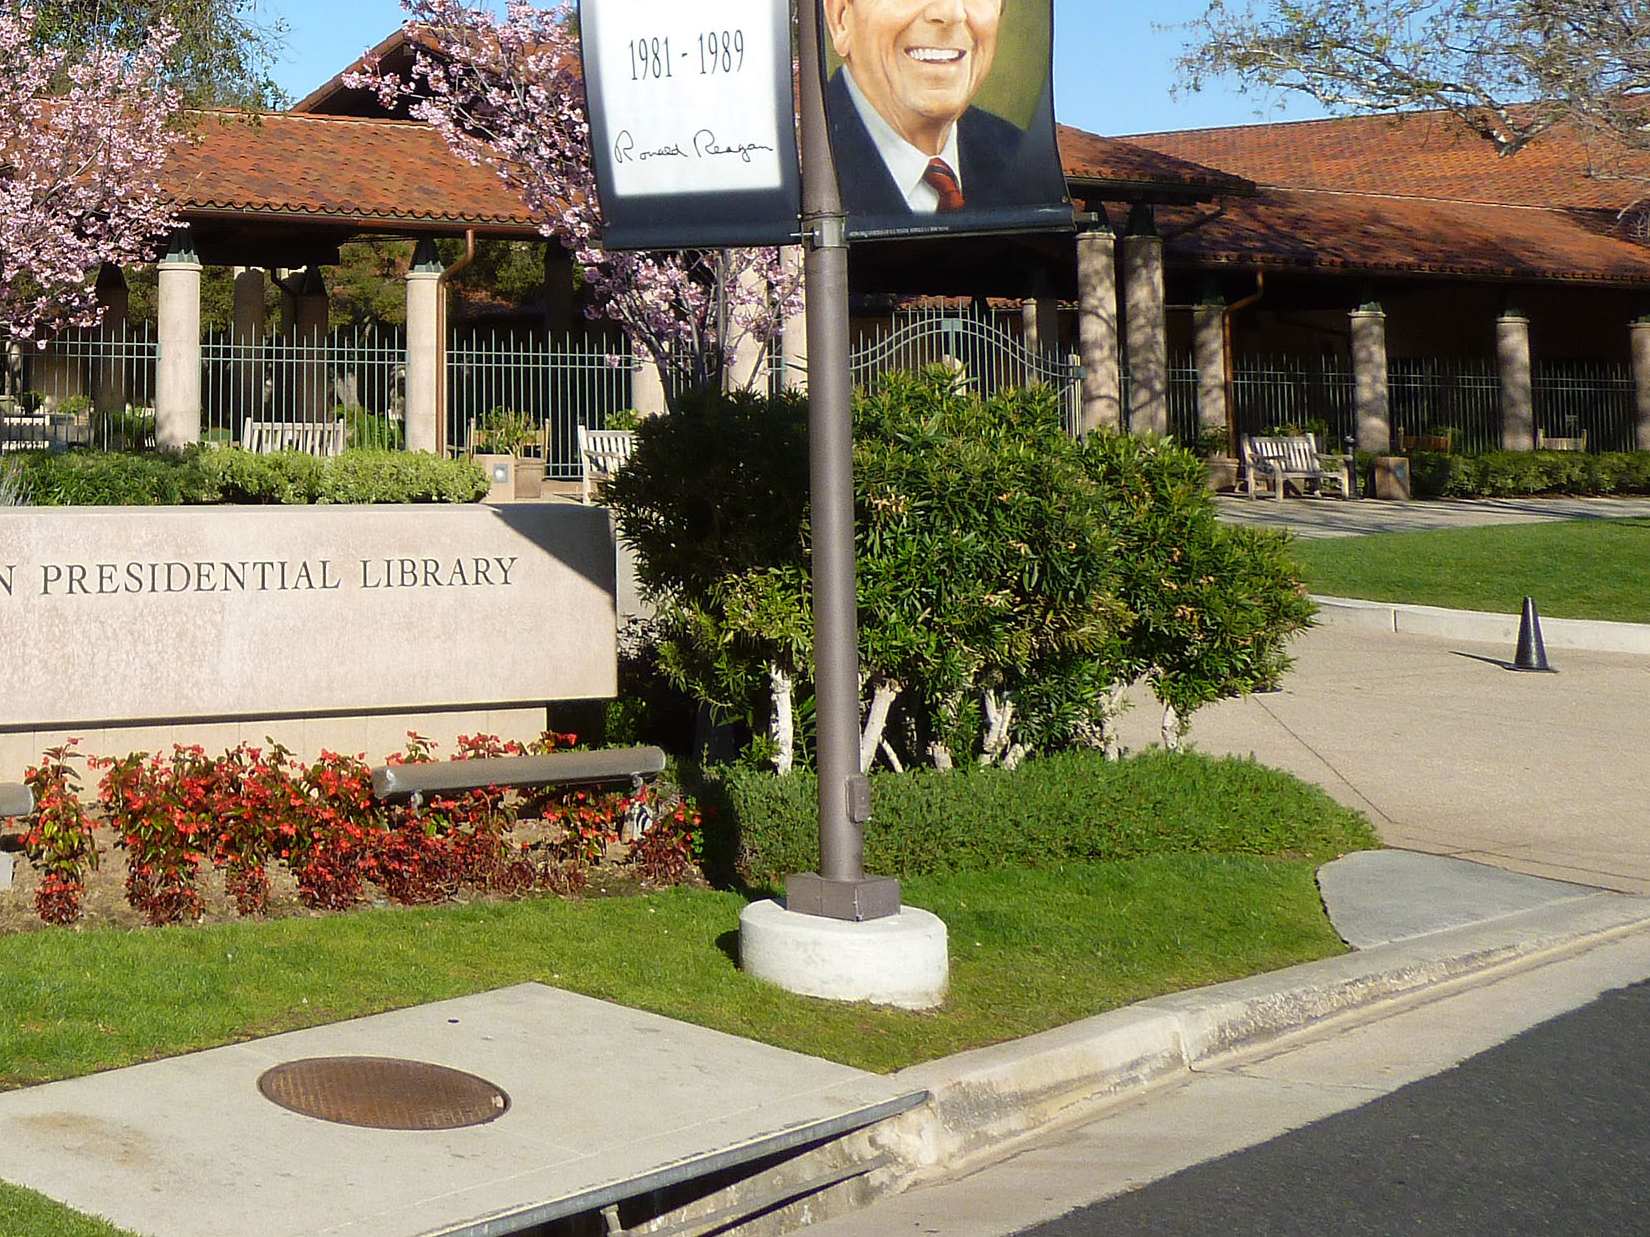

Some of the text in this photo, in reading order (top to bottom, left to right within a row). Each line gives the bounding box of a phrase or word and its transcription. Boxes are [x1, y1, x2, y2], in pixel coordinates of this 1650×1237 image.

[628, 37, 673, 80] 1981
[699, 29, 744, 75] 1989
[614, 129, 773, 163] Ronald Reagan
[40, 560, 341, 596] PRESIDENTIAL
[359, 556, 518, 589] LIBRARY
